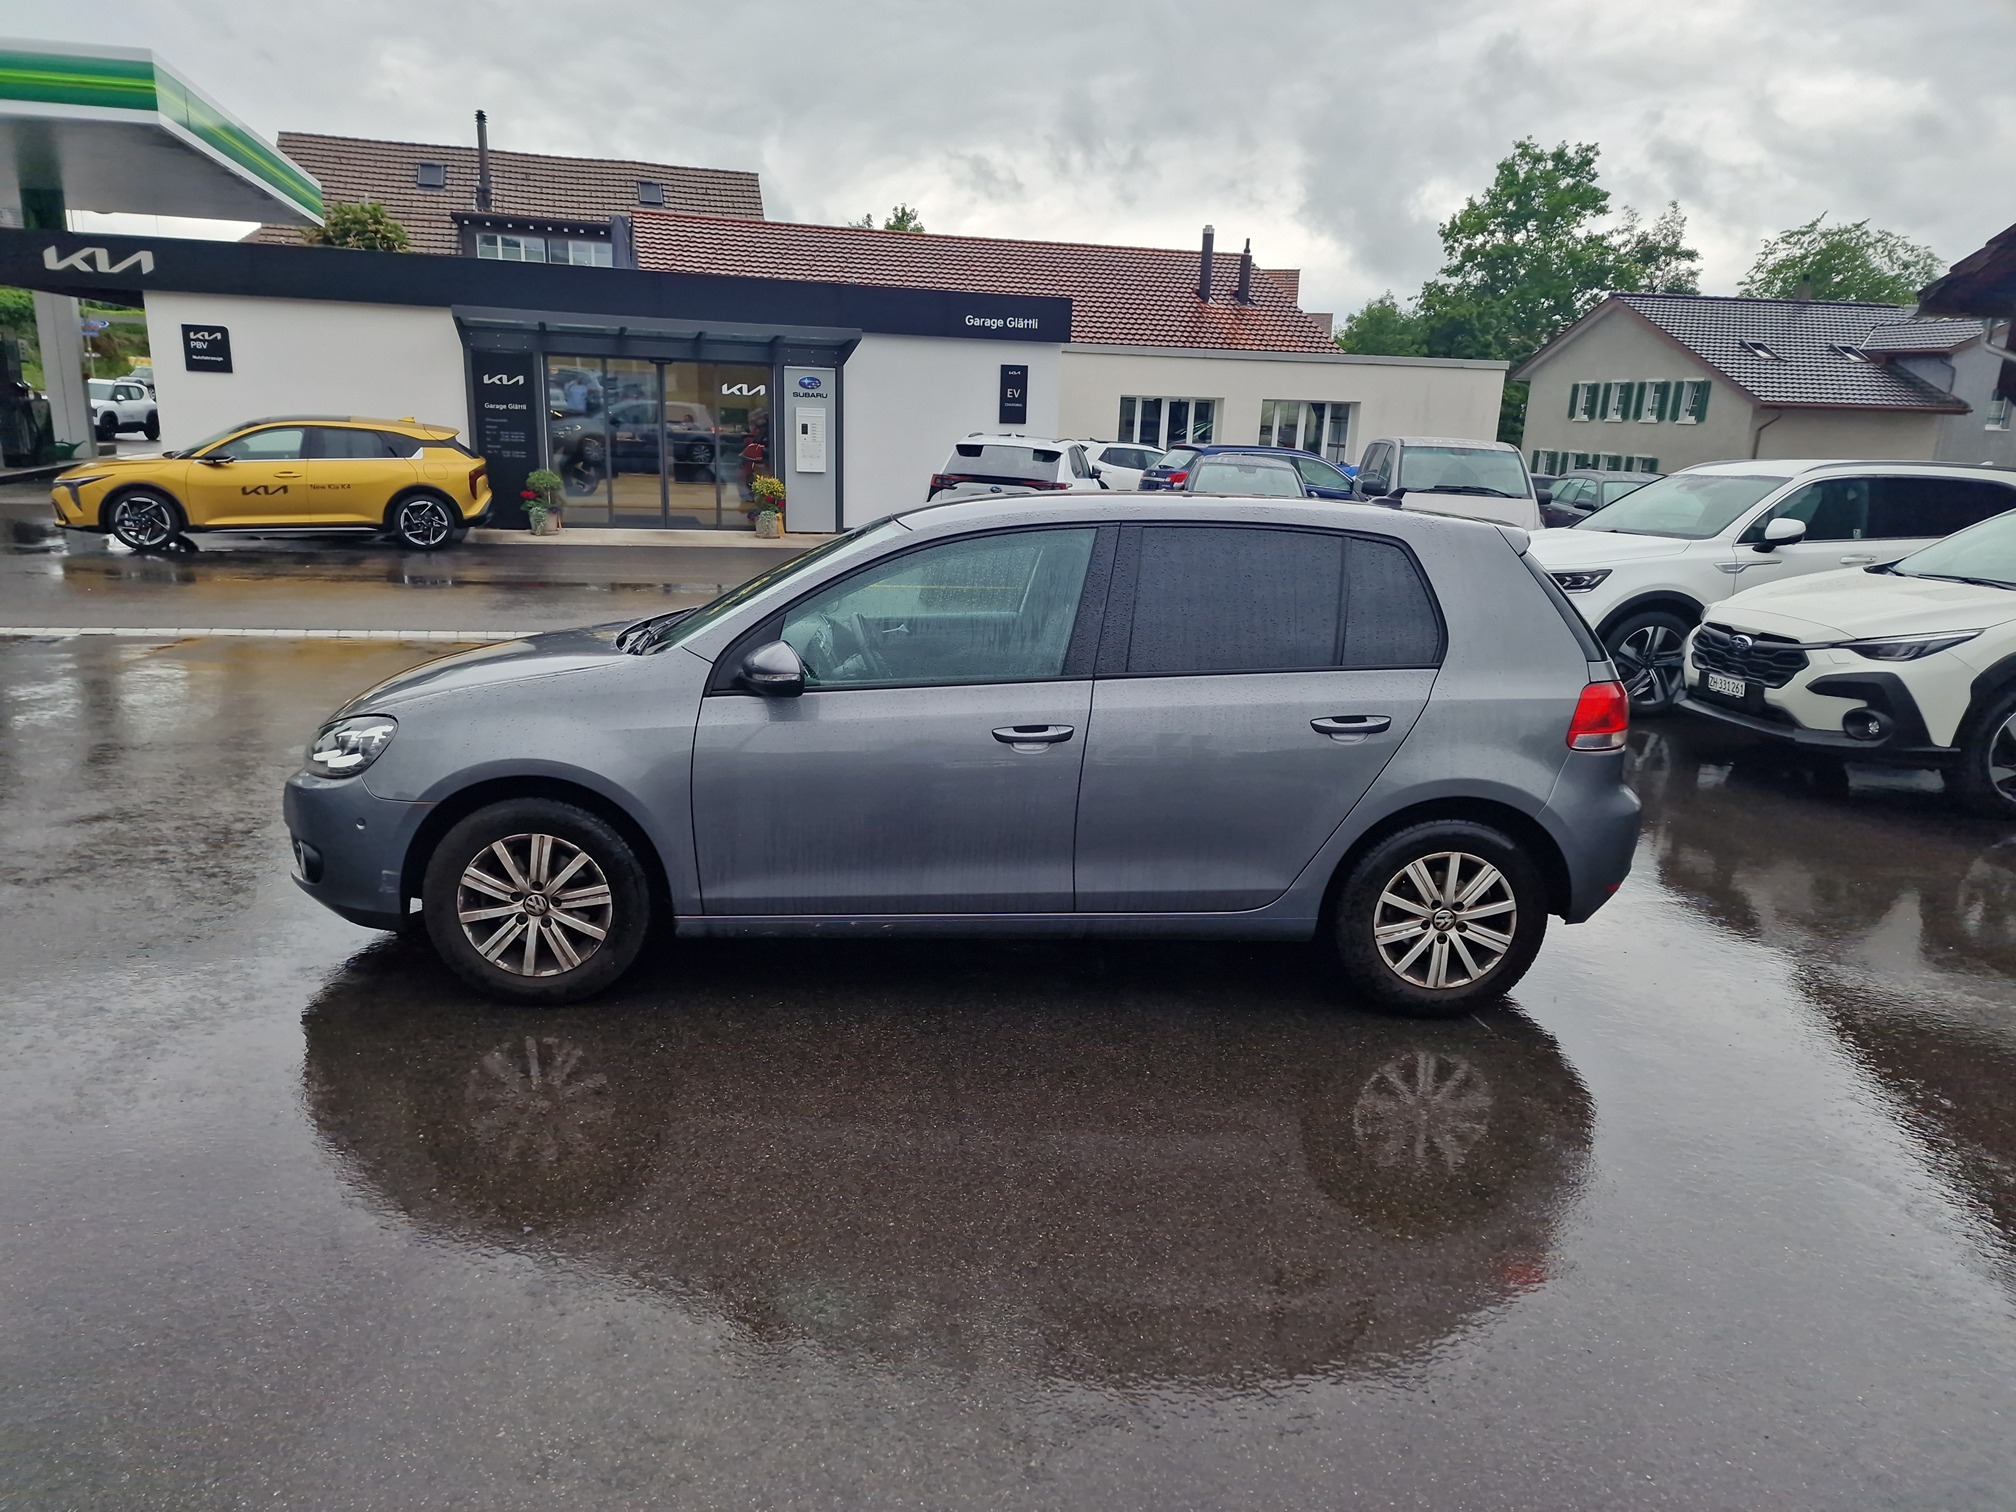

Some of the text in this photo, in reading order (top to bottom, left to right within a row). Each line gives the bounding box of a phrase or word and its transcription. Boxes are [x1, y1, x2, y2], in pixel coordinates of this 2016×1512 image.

[42, 245, 155, 275] KIA
[965, 315, 1039, 330] Garage Glättli
[190, 331, 222, 340] KIA
[190, 341, 208, 349] PBV
[483, 374, 525, 385] KIA
[721, 383, 766, 396] KIA
[1006, 388, 1021, 398] EV
[792, 391, 828, 399] SUBARU
[484, 402, 507, 411] Garage
[241, 484, 289, 496] KIA
